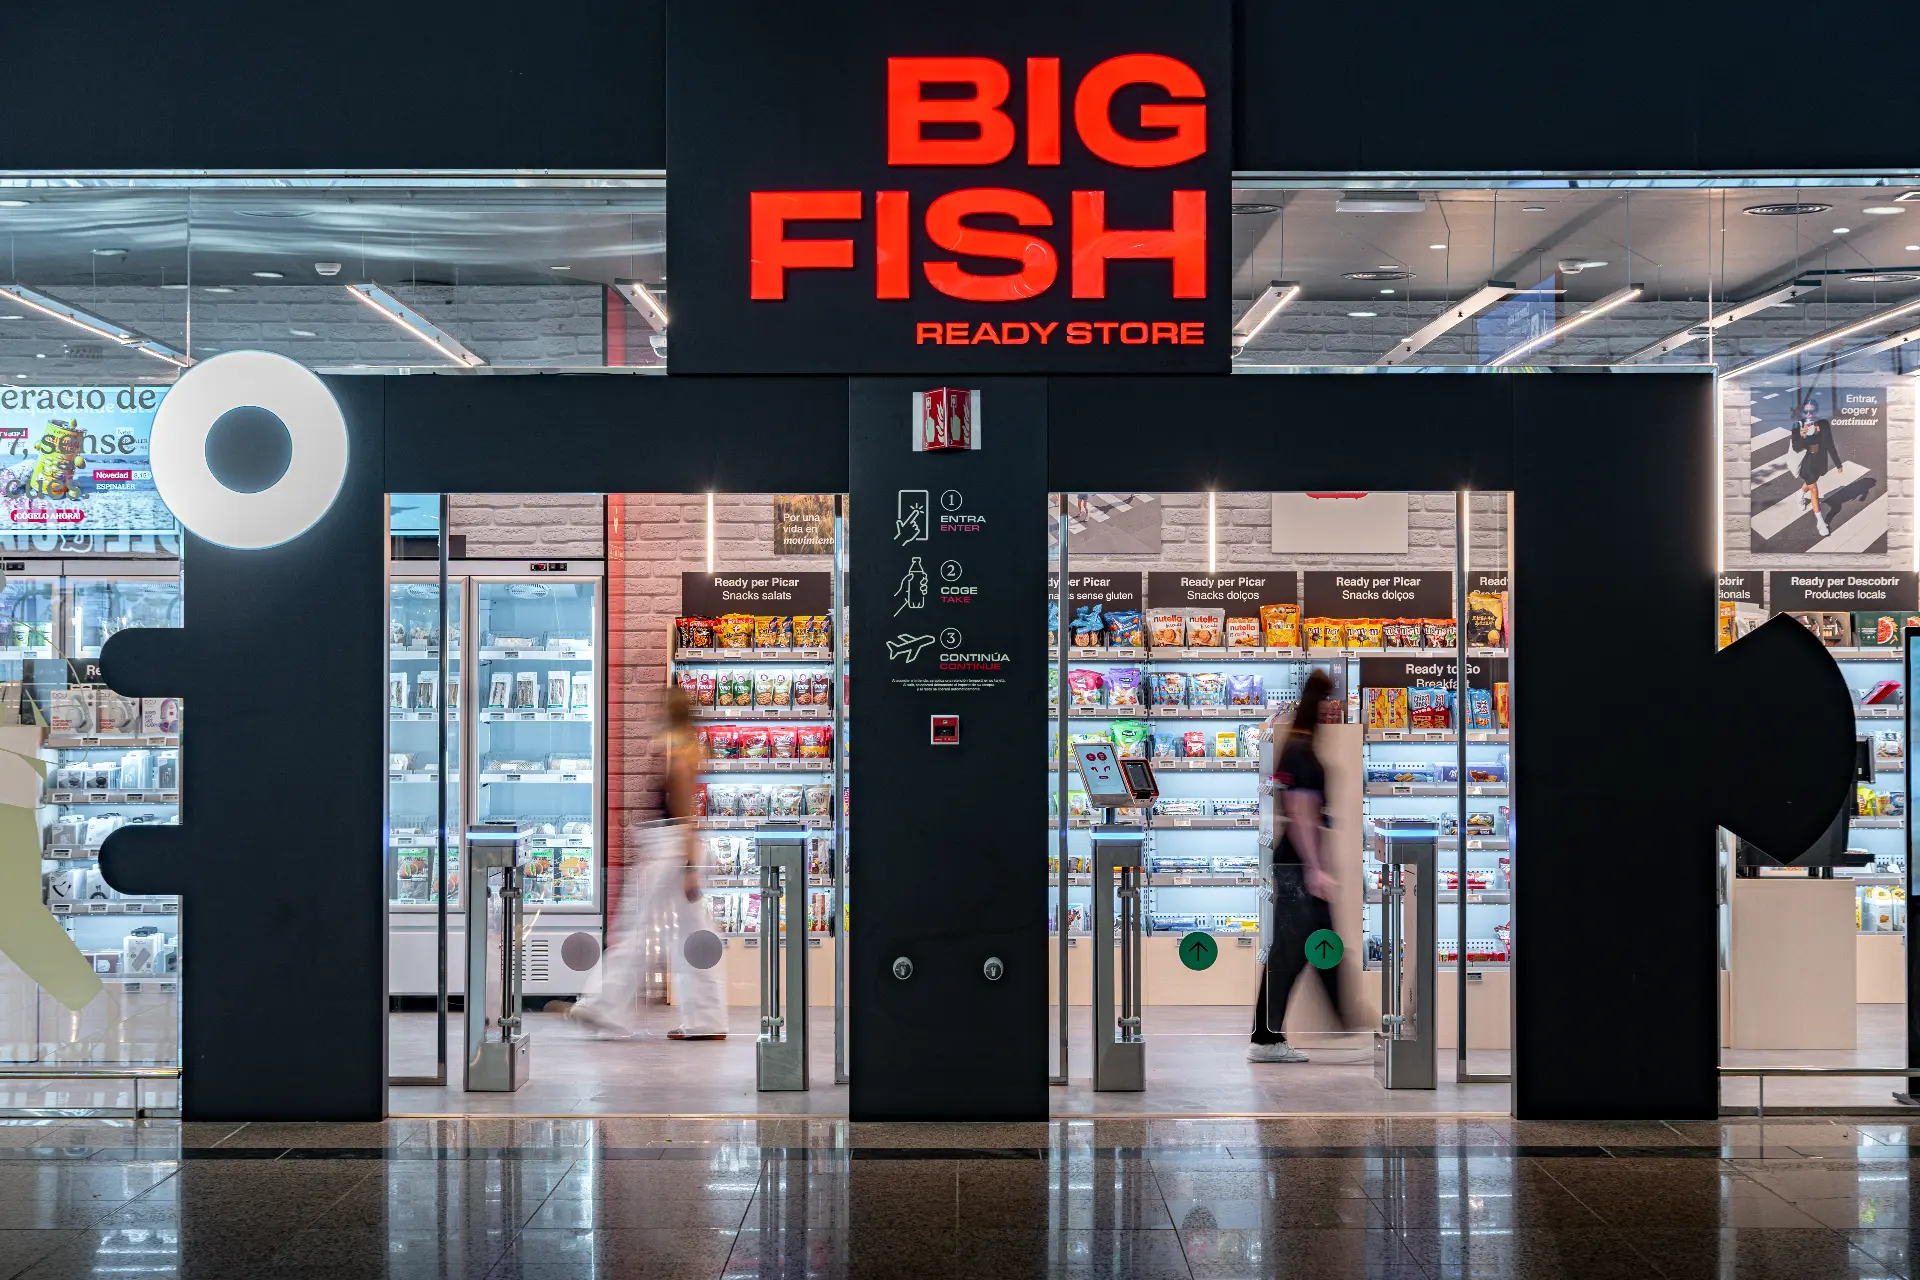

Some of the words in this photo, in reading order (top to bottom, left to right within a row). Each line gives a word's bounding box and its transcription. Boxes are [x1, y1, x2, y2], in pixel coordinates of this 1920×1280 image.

[888, 53, 1207, 168] BIG
[750, 187, 1207, 302] FISH
[916, 322, 1059, 345] READY
[1066, 322, 1205, 345] STORE
[117, 382, 156, 410] de
[1846, 394, 1878, 406] Entrar,
[1841, 406, 1869, 418] coger
[1871, 407, 1878, 417] y
[1831, 417, 1879, 427] continuar
[40, 433, 136, 456] sense
[96, 471, 129, 479] Novedad
[6, 480, 90, 501] cues.
[50, 511, 81, 520] AHORA!
[783, 513, 800, 522] Por
[940, 515, 986, 523] ENTRA
[783, 525, 803, 533] vida
[940, 524, 980, 532] ENTER
[714, 577, 748, 589] Ready
[751, 580, 769, 589] per
[771, 577, 800, 587] Picar
[1083, 577, 1111, 587] Picar
[1181, 577, 1214, 589] Ready
[1217, 580, 1236, 589] per
[1238, 577, 1266, 587] Picar
[1336, 577, 1370, 588] Ready
[1372, 579, 1391, 588] per
[1393, 576, 1421, 586] Picar
[1791, 577, 1825, 588] Ready
[1827, 579, 1846, 588] per
[1847, 576, 1900, 587] Descobrir
[722, 590, 759, 601] Snacks
[761, 590, 792, 601] salats
[940, 586, 978, 595] COGE
[1341, 590, 1379, 600] Snacks
[1381, 589, 1415, 602] dolços
[1804, 589, 1855, 600] Productes
[1857, 589, 1887, 600] locals
[940, 596, 971, 604] TAKE
[1076, 592, 1104, 600] sense
[1105, 591, 1133, 602] gluten
[1187, 590, 1224, 601] Snacks
[1226, 590, 1260, 603] dolços
[1153, 614, 1183, 623] nutella
[1189, 615, 1219, 623] nutella
[940, 652, 1011, 662] CONTINÚA
[940, 663, 1001, 671] CONTINUE
[1405, 663, 1444, 677] Ready
